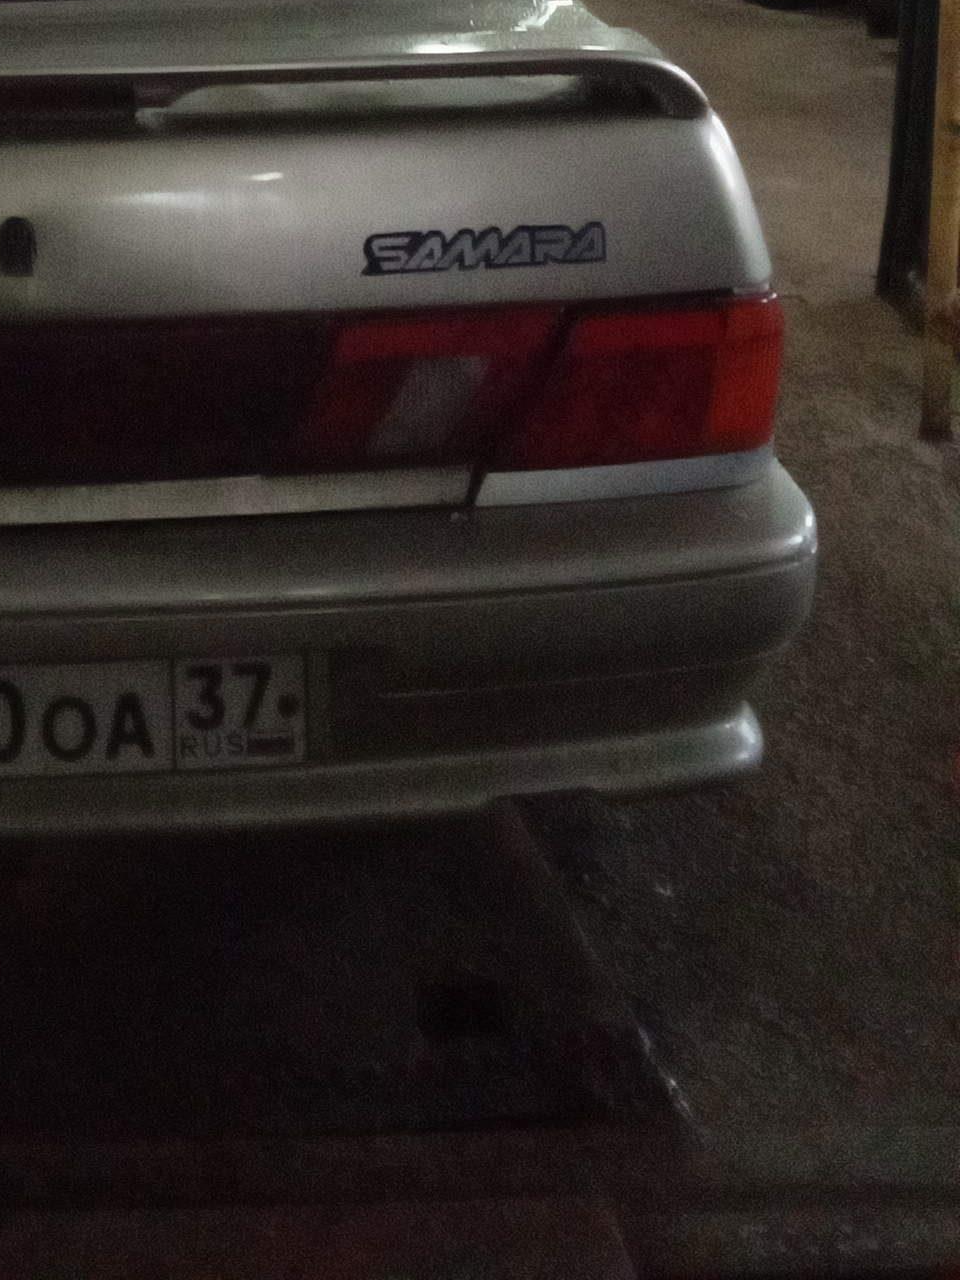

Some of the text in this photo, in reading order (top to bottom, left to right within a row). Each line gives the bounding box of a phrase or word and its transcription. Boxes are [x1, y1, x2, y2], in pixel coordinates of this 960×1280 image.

[362, 221, 606, 275] SAMARA
[188, 663, 272, 729] 37
[180, 733, 244, 757] RUS
